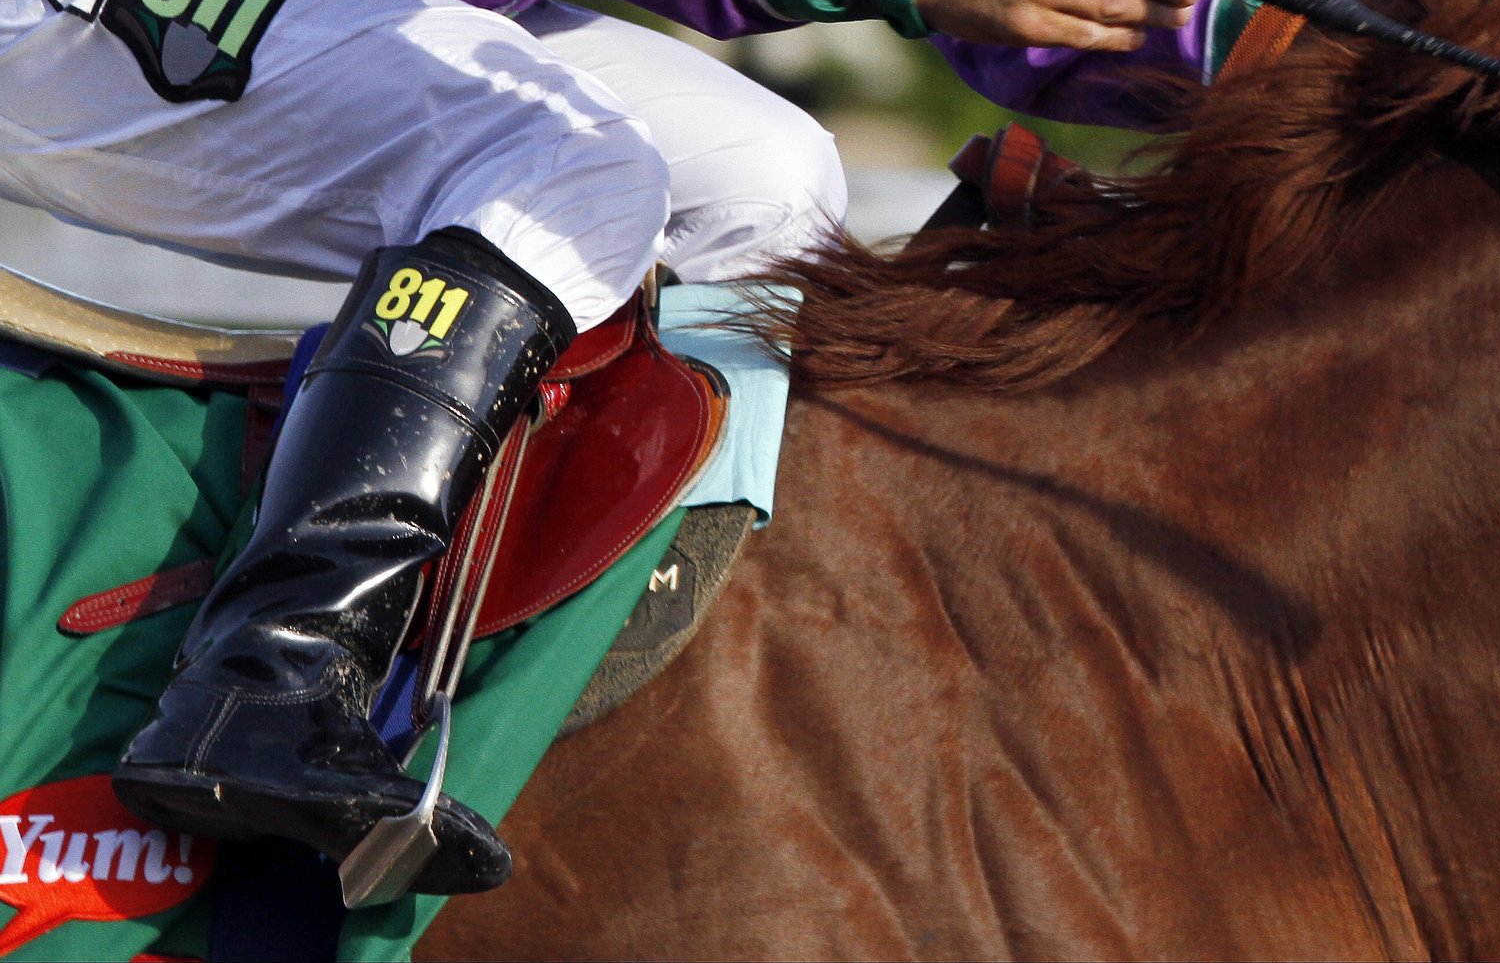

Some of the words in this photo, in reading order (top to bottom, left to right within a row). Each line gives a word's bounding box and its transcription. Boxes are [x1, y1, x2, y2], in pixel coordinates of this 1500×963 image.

[376, 267, 469, 340] 811
[648, 564, 678, 592] M
[0, 814, 193, 884] Yum!
